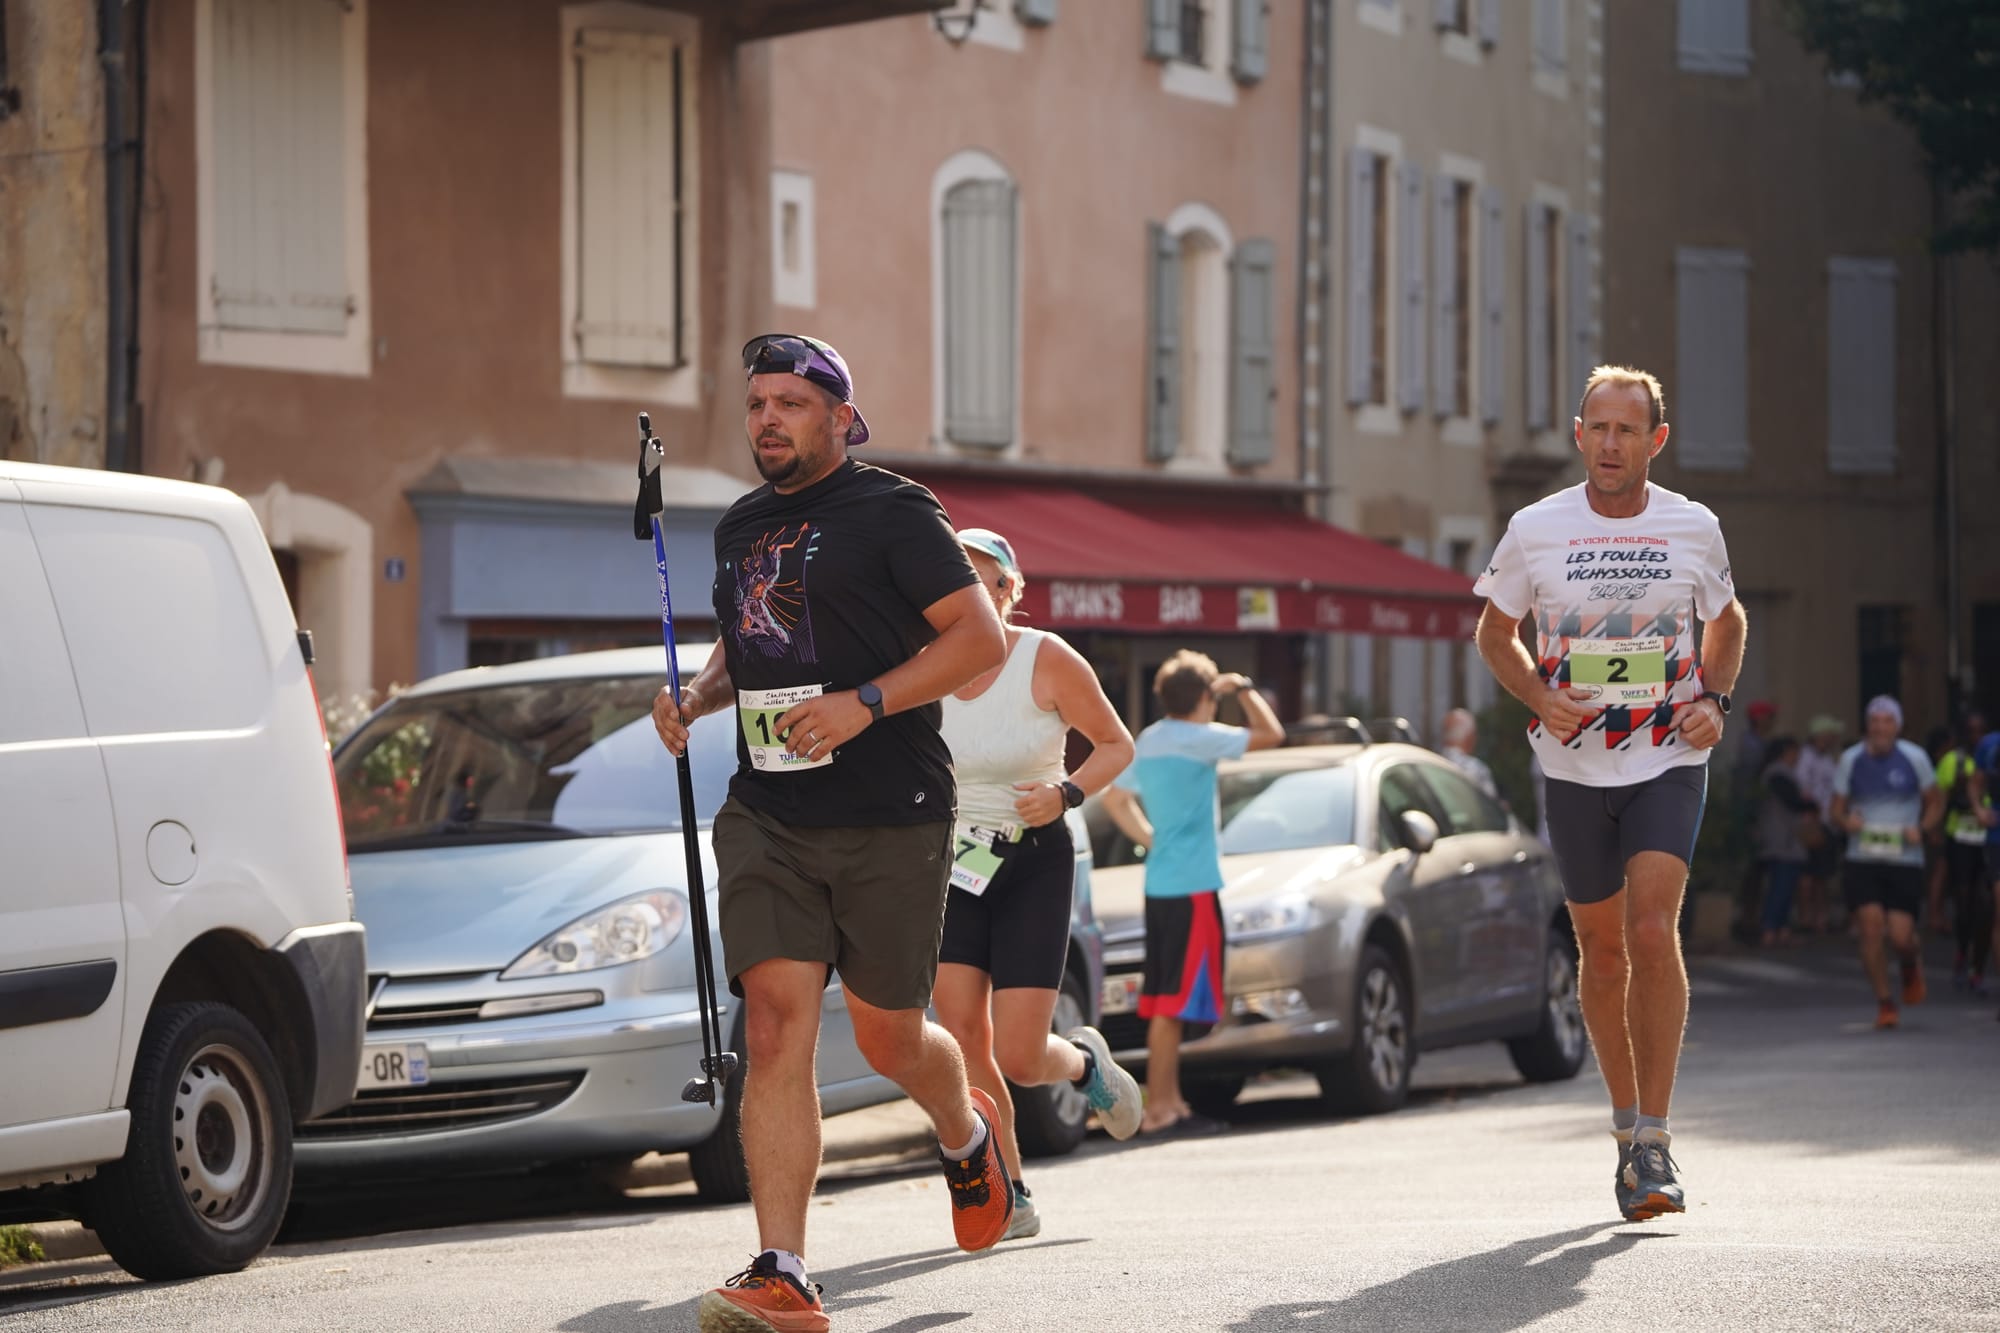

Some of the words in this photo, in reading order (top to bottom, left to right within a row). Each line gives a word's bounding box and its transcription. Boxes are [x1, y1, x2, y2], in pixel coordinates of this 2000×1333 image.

[1569, 538, 1581, 547] RC
[1583, 536, 1611, 545] VICHY
[1566, 551, 1596, 564] LES
[1600, 547, 1669, 563] FOULÉES
[658, 572, 670, 624] FISCHER
[1587, 583, 1651, 600] 2025
[1160, 585, 1203, 623] BAR
[1607, 657, 1629, 683] 2
[765, 690, 798, 700] Challenge
[955, 839, 977, 862] 7
